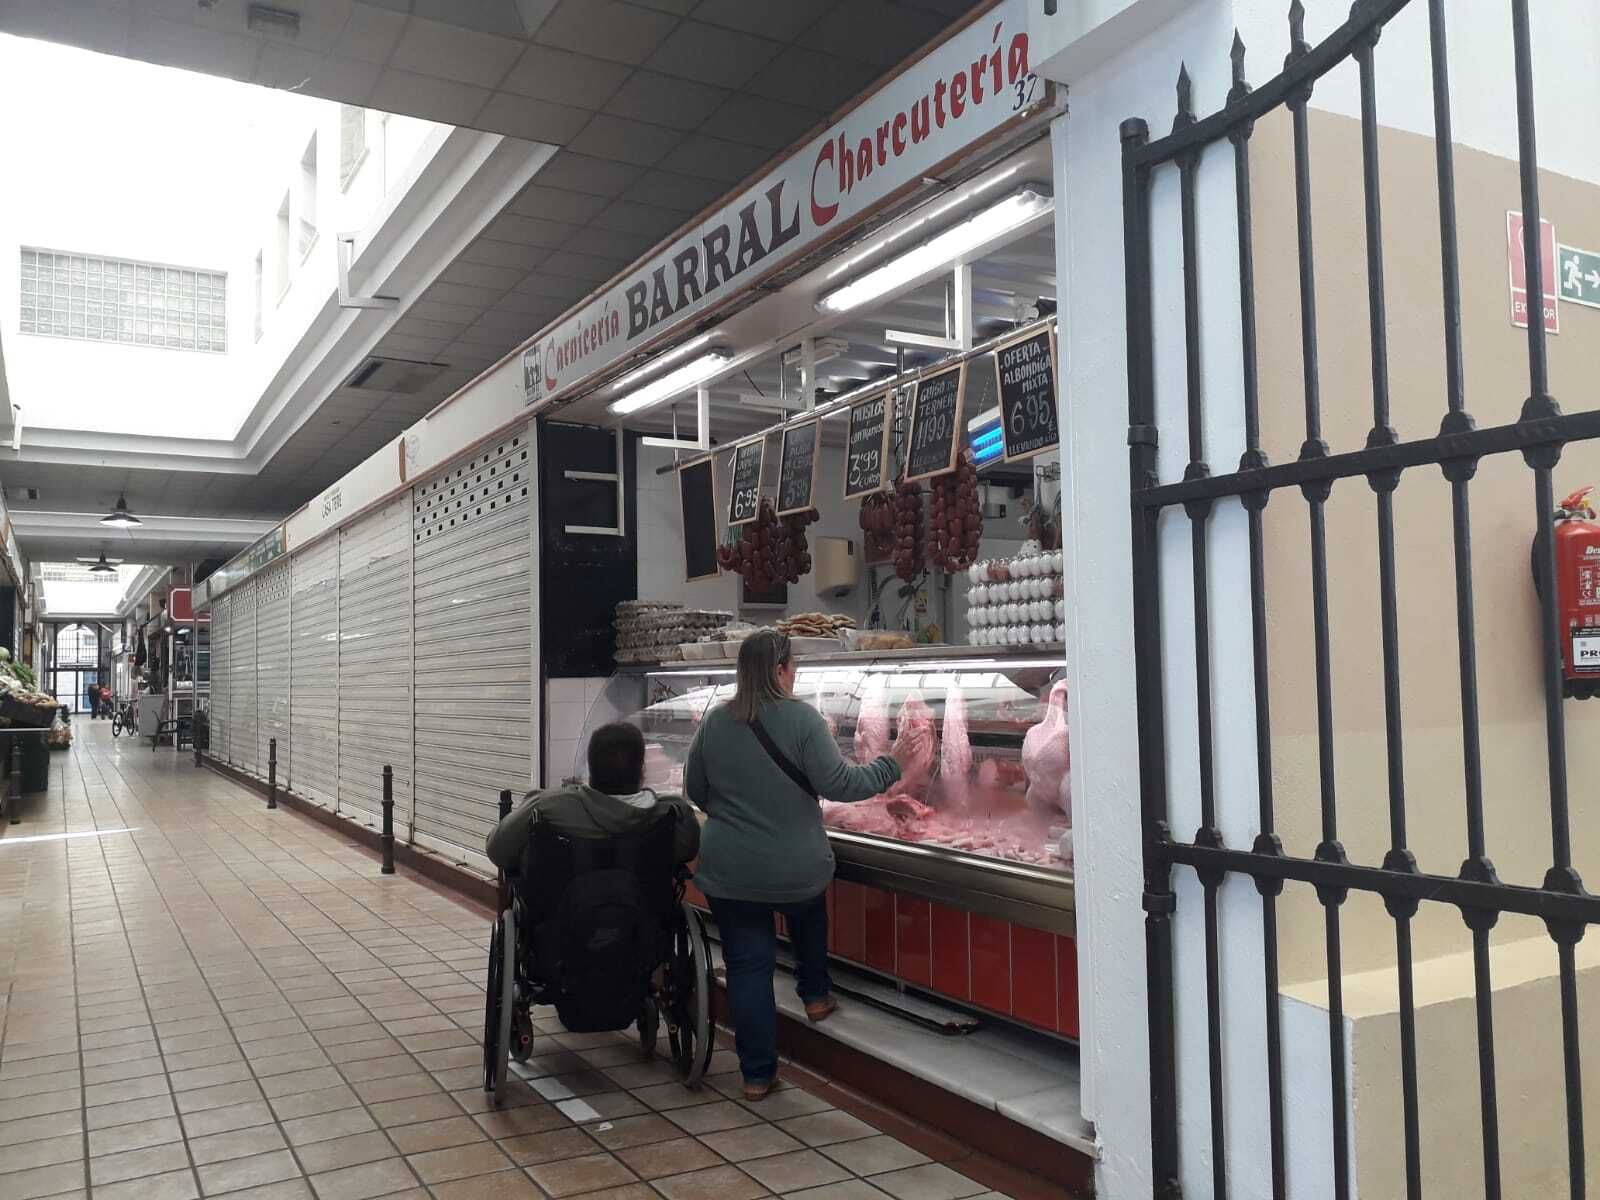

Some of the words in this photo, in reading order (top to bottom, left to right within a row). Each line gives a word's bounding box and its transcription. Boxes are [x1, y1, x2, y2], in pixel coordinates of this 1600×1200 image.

[1012, 73, 1038, 111] 37
[544, 301, 620, 391] Carnicería
[625, 179, 800, 341] BARRAL
[810, 21, 1029, 227] Charcutería
[1004, 341, 1041, 367] OFERTA
[849, 449, 879, 486] 3'99
